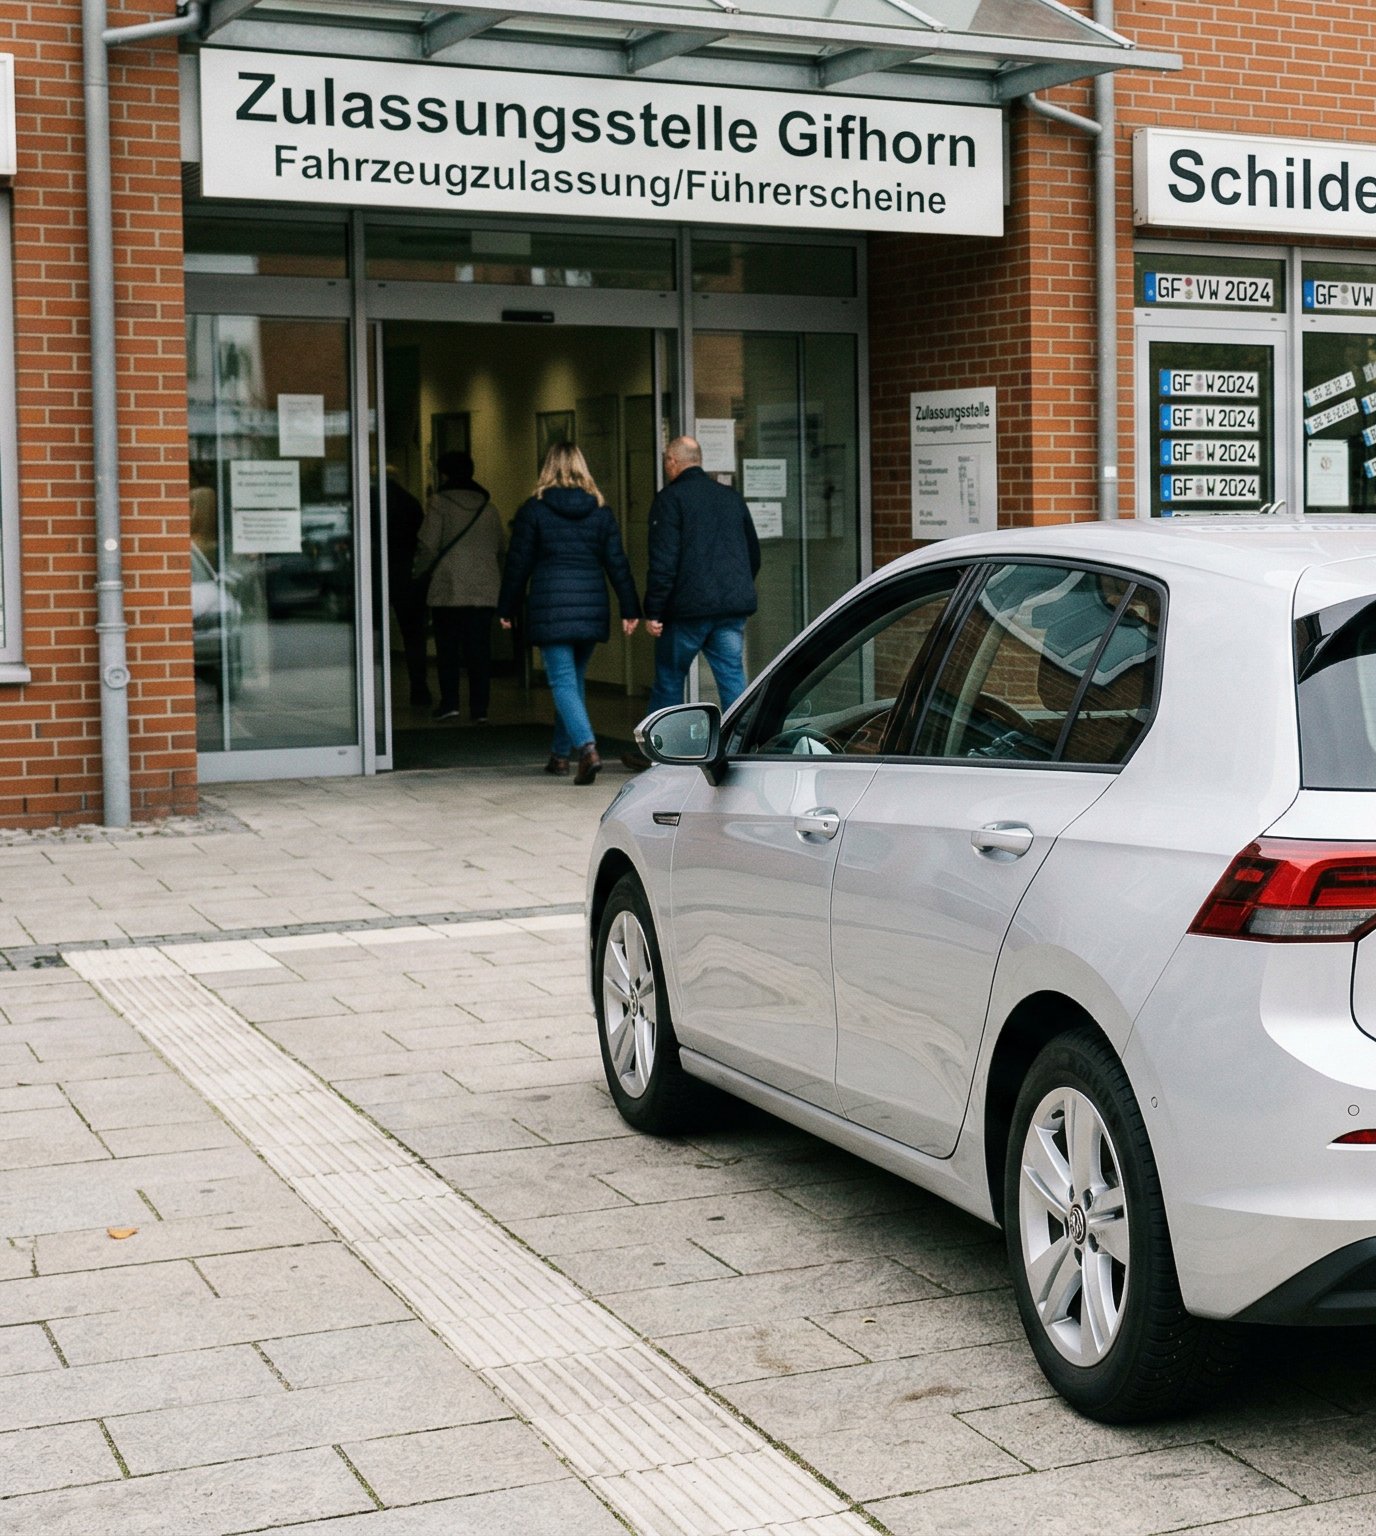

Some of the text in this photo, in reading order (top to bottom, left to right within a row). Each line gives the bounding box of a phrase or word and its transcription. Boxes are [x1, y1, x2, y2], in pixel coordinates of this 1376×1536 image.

[236, 72, 976, 168] Zulassungsstelle Gifhorn
[276, 145, 946, 215] Fahrzeugzulassung/Führerscheine
[1158, 277, 1271, 302] GF VW 2024
[1316, 284, 1339, 305] GF
[1351, 286, 1373, 306] VW
[1173, 373, 1193, 392] GF
[1217, 375, 1255, 393] 2024
[1173, 408, 1193, 427] GF
[1219, 409, 1255, 427] 2024
[1173, 443, 1194, 461] GF
[1219, 444, 1256, 462] 2024
[1173, 478, 1193, 496] GF
[1219, 478, 1256, 496] 2024
